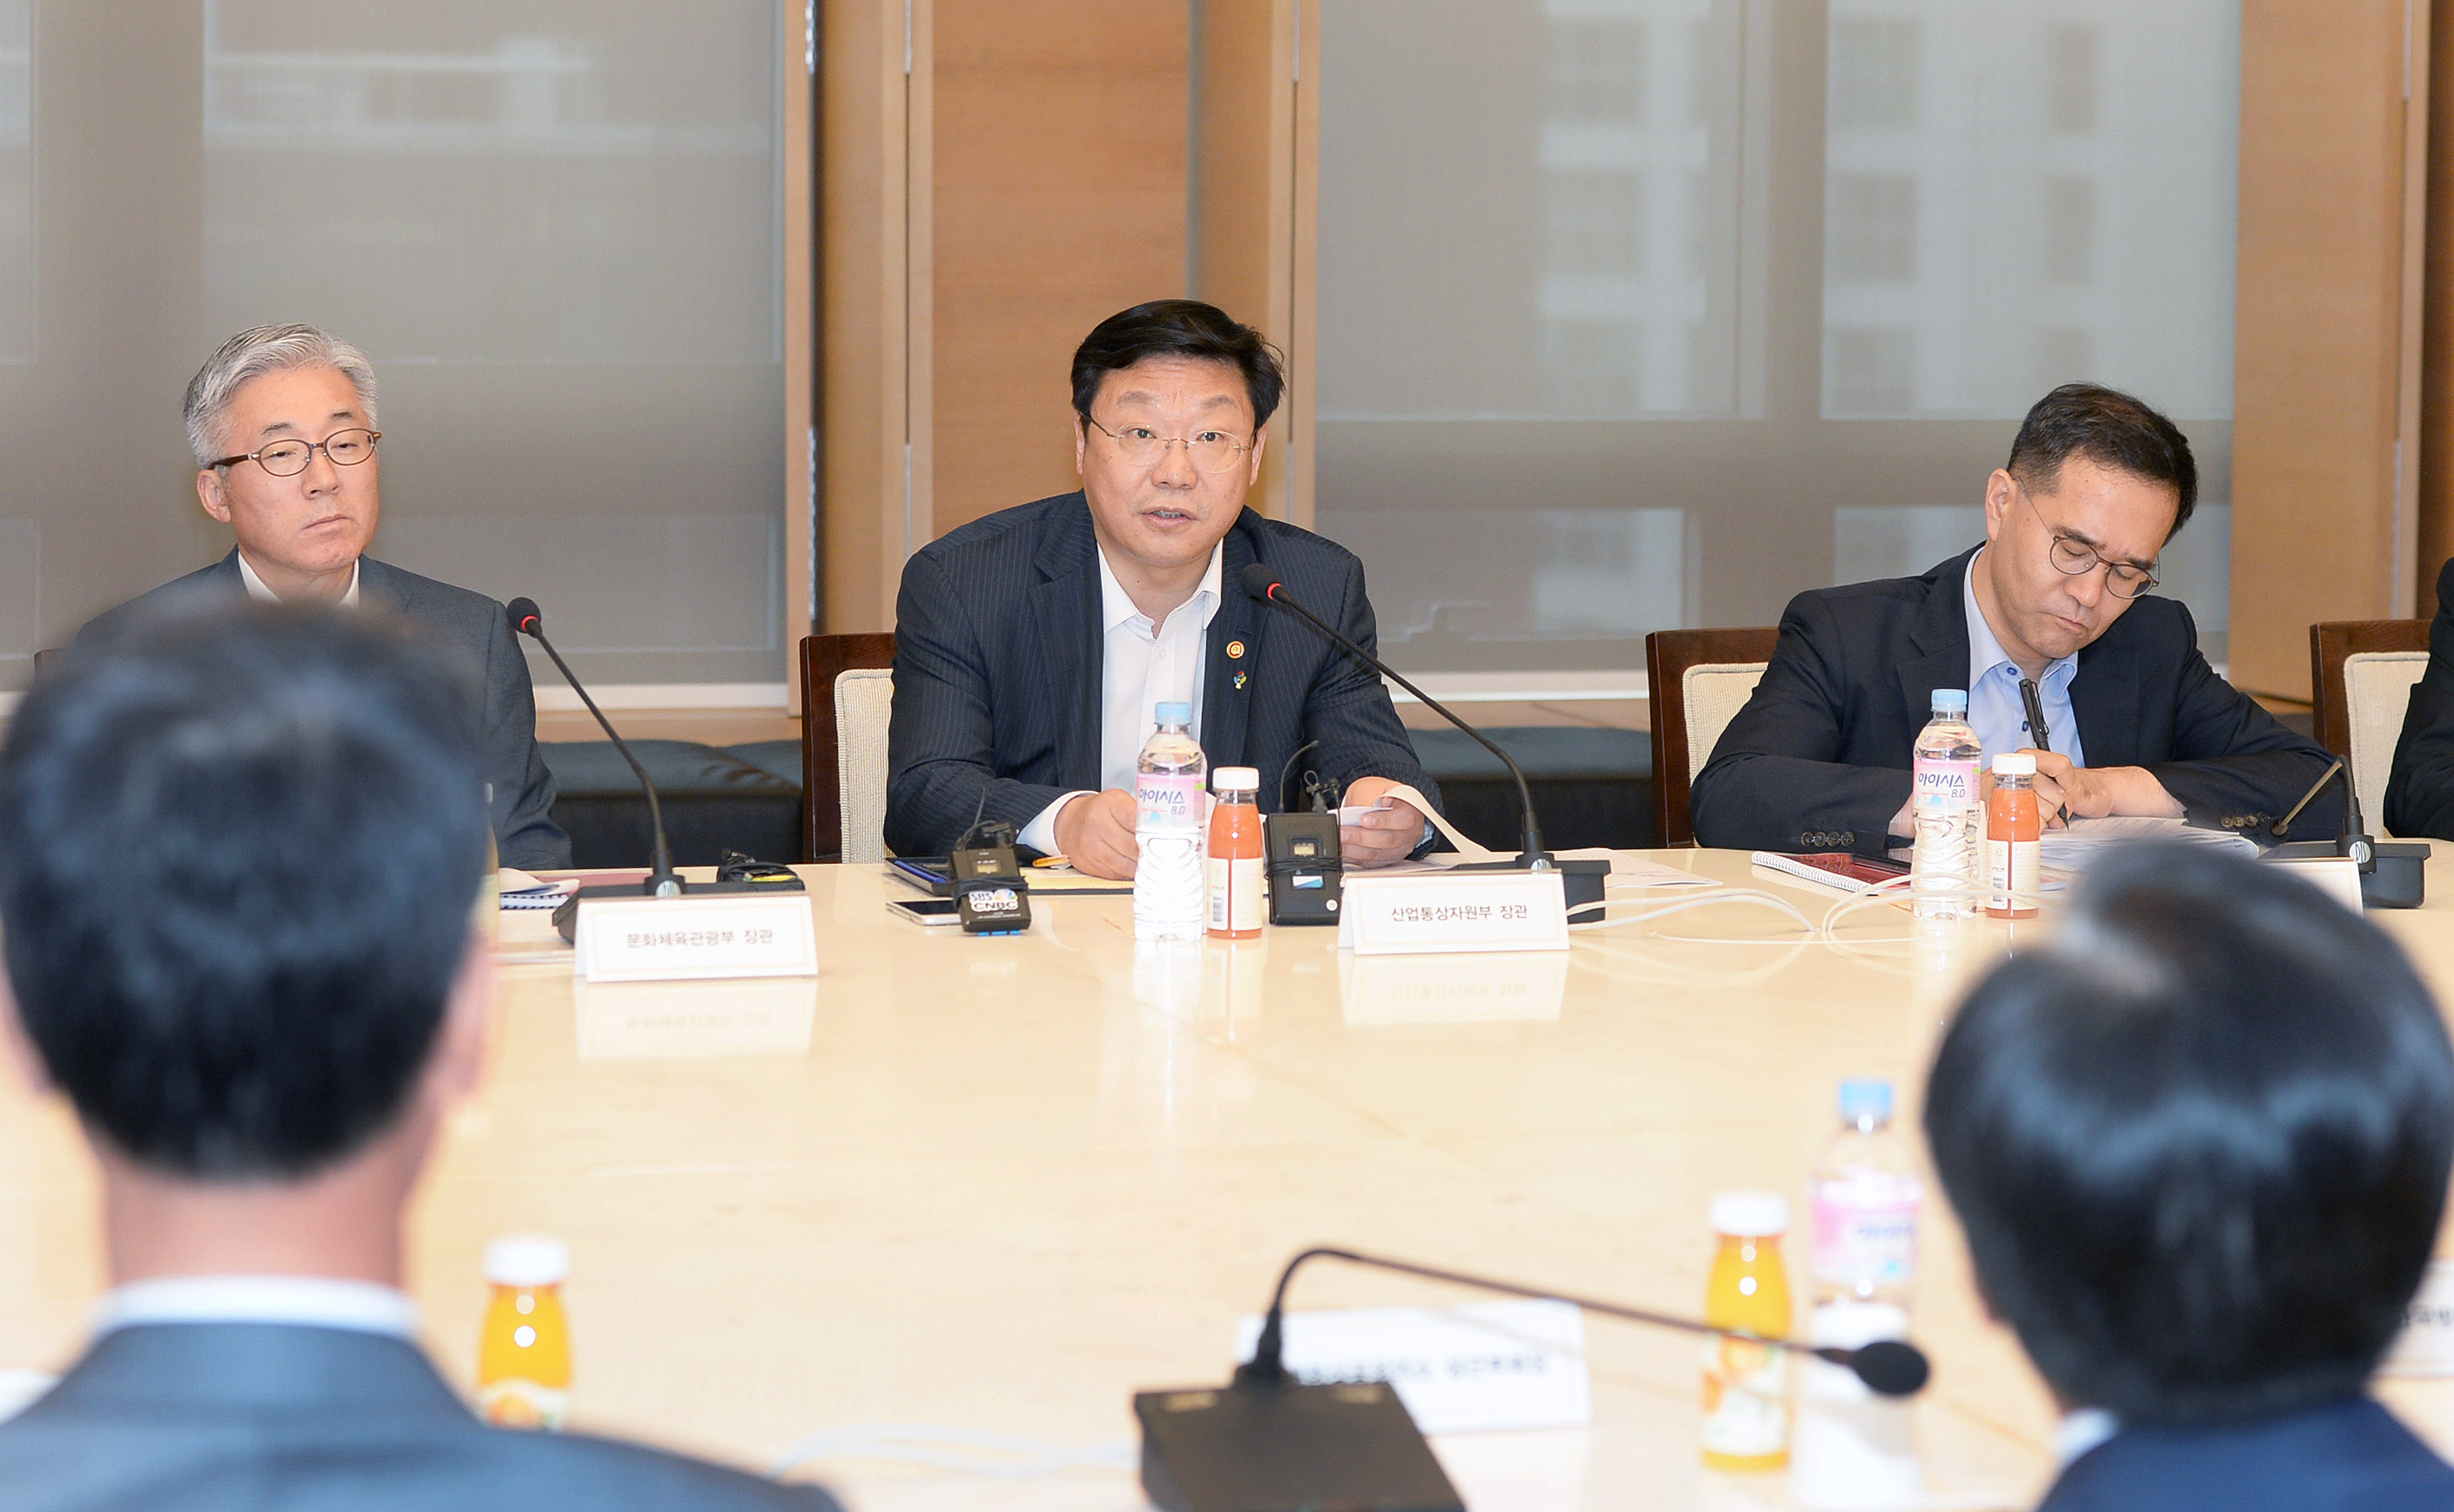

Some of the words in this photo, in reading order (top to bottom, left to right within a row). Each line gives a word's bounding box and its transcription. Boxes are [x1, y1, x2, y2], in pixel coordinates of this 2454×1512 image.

[1918, 773, 1965, 787] 아이시스
[1139, 788, 1184, 805] 아이시스
[1951, 788, 1966, 799] 8.0
[1170, 806, 1186, 815] 8.0
[971, 892, 993, 901] SBS
[974, 901, 1017, 910] CNBC
[1391, 905, 1492, 922] 산업통상자원부
[1500, 904, 1528, 920] 장관
[744, 929, 774, 945] 장관
